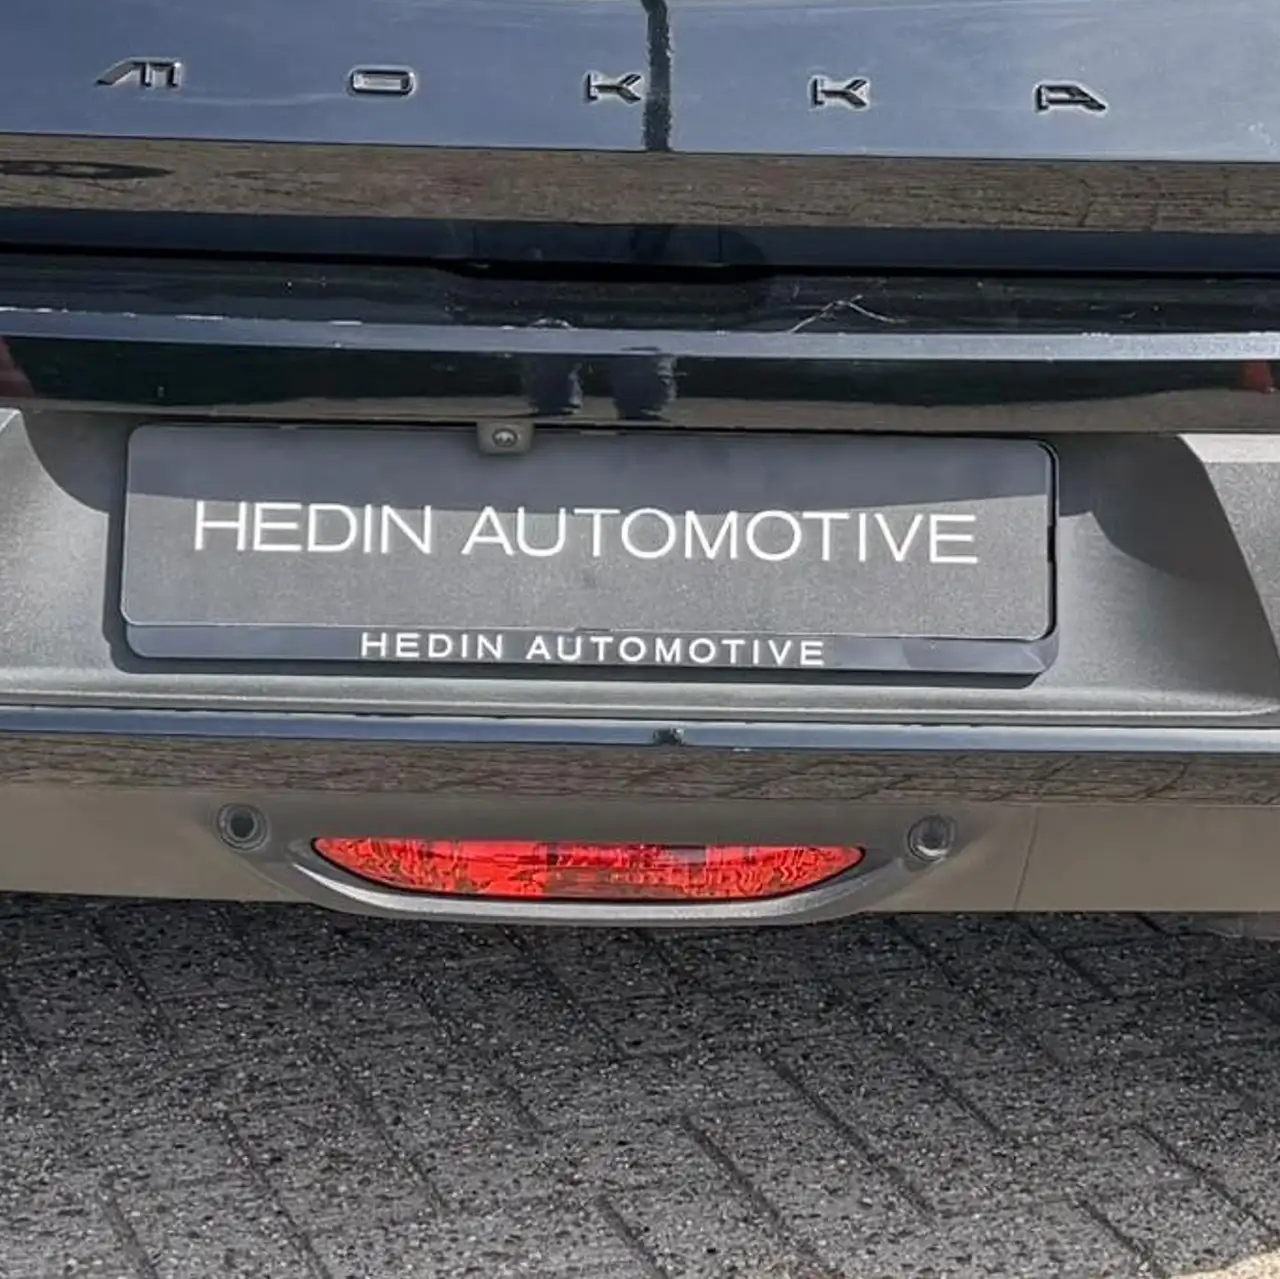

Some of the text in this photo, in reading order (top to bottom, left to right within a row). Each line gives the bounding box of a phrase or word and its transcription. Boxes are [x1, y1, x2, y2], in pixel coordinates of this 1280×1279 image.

[95, 56, 1108, 114] MOKKA
[192, 500, 979, 565] HEDIN AUTOMOTIVE
[359, 631, 826, 668] HEDIN AUTOMOTIVE
